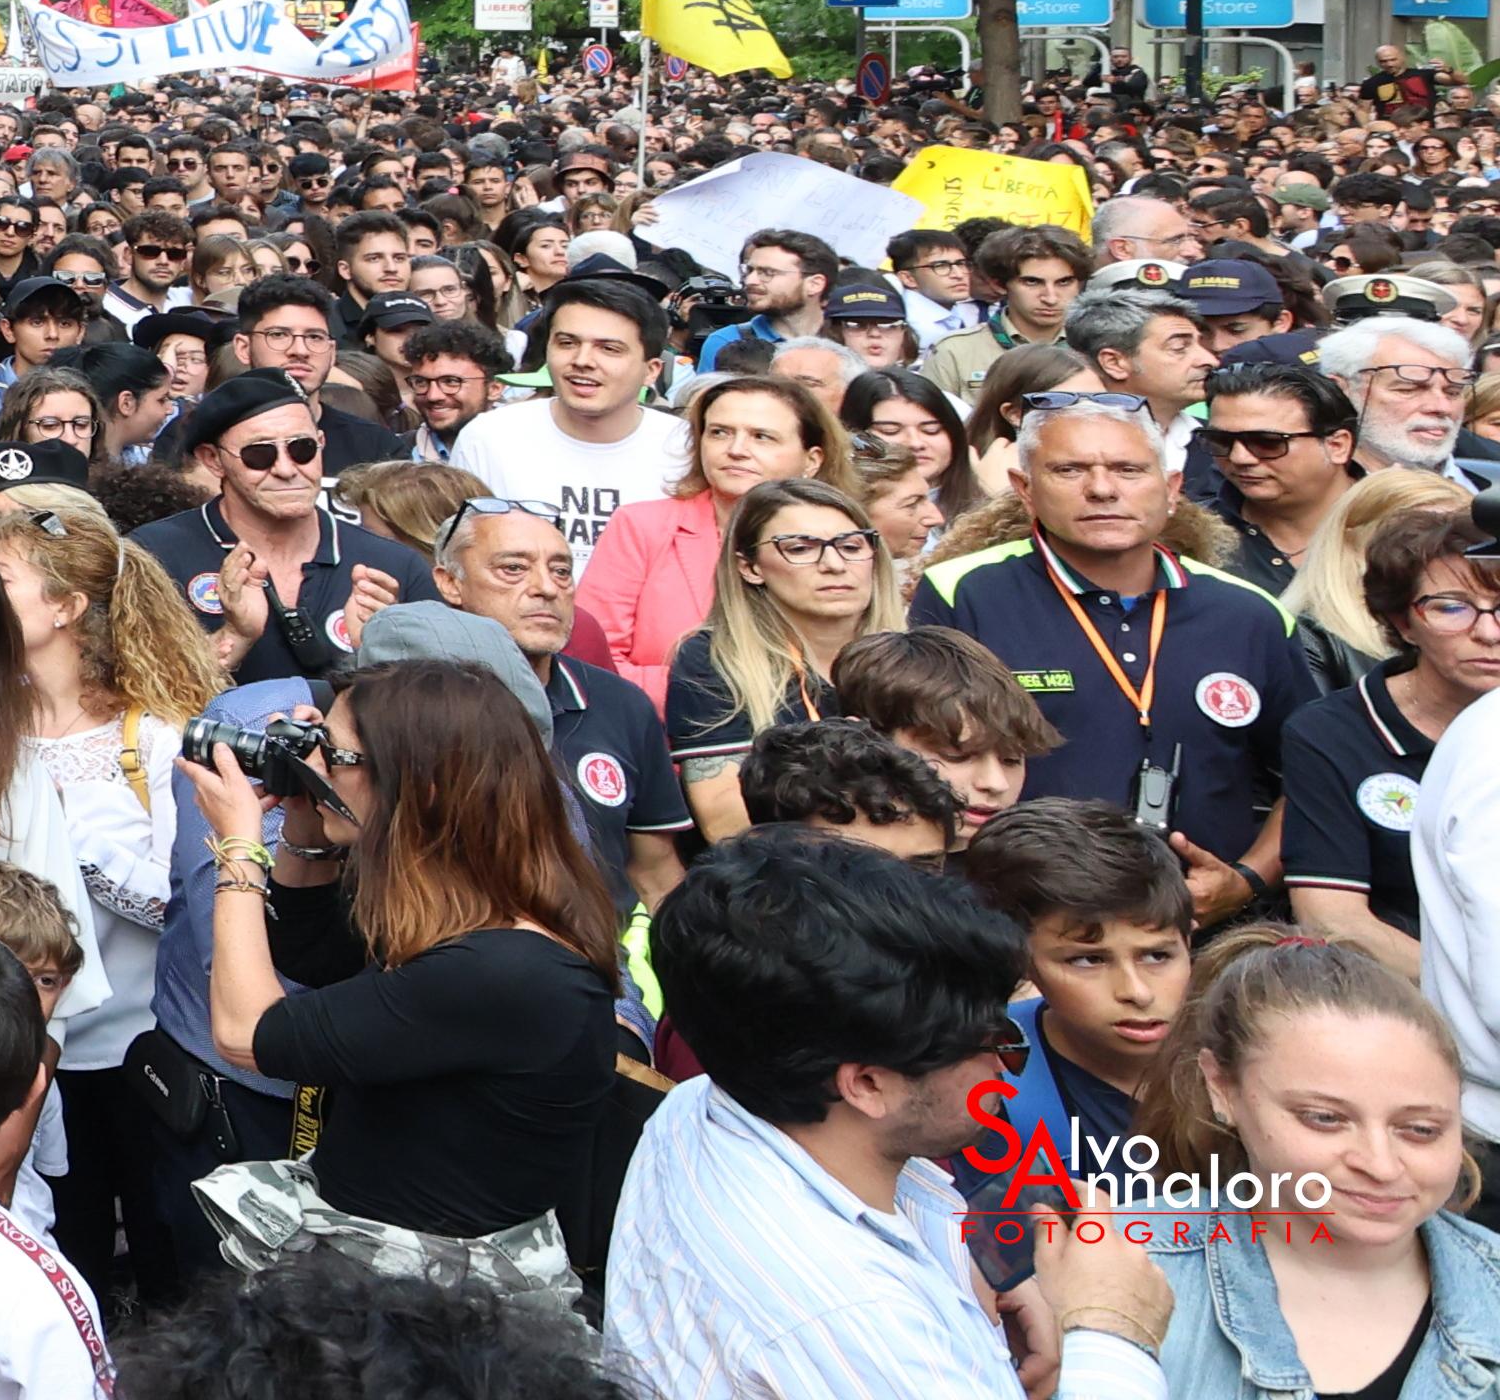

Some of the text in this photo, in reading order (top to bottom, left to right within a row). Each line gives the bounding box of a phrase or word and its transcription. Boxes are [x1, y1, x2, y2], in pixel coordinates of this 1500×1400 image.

[482, 4, 526, 12] LIBERO
[561, 485, 620, 517] NO
[144, 1064, 171, 1098] Canon
[56, 1277, 103, 1357] CAMPUS
